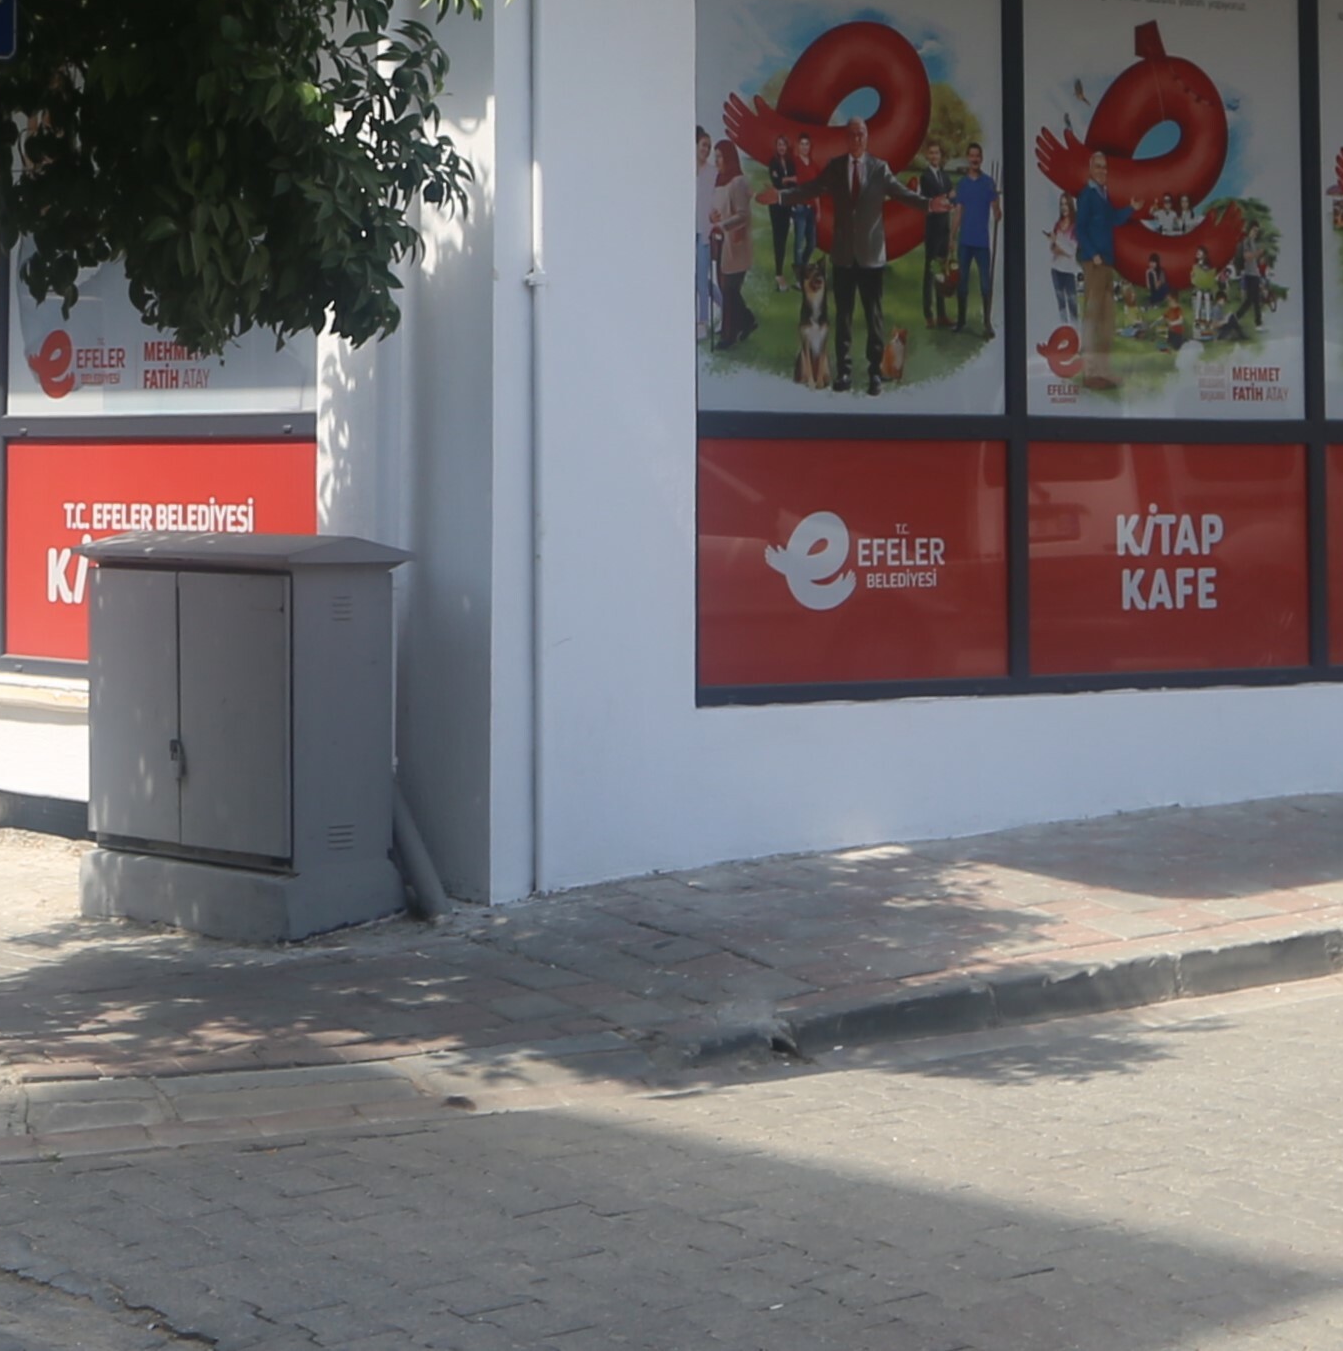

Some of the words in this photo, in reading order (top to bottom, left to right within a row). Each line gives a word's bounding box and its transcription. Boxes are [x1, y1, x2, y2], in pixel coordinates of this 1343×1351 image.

[75, 347, 126, 369] EFELER
[143, 362, 179, 389] FATİH
[181, 367, 210, 389] ATAY
[1231, 365, 1281, 382] MEHMET
[1231, 381, 1264, 401] FATİH
[63, 501, 90, 531] T.C.
[92, 502, 153, 532] EFELER
[156, 496, 255, 534] BELEDİYESİ
[1115, 502, 1225, 556] KİTAP
[857, 537, 946, 567] EFELER
[865, 568, 938, 590] BELEDİYESİ
[1120, 567, 1218, 611] KAFE
